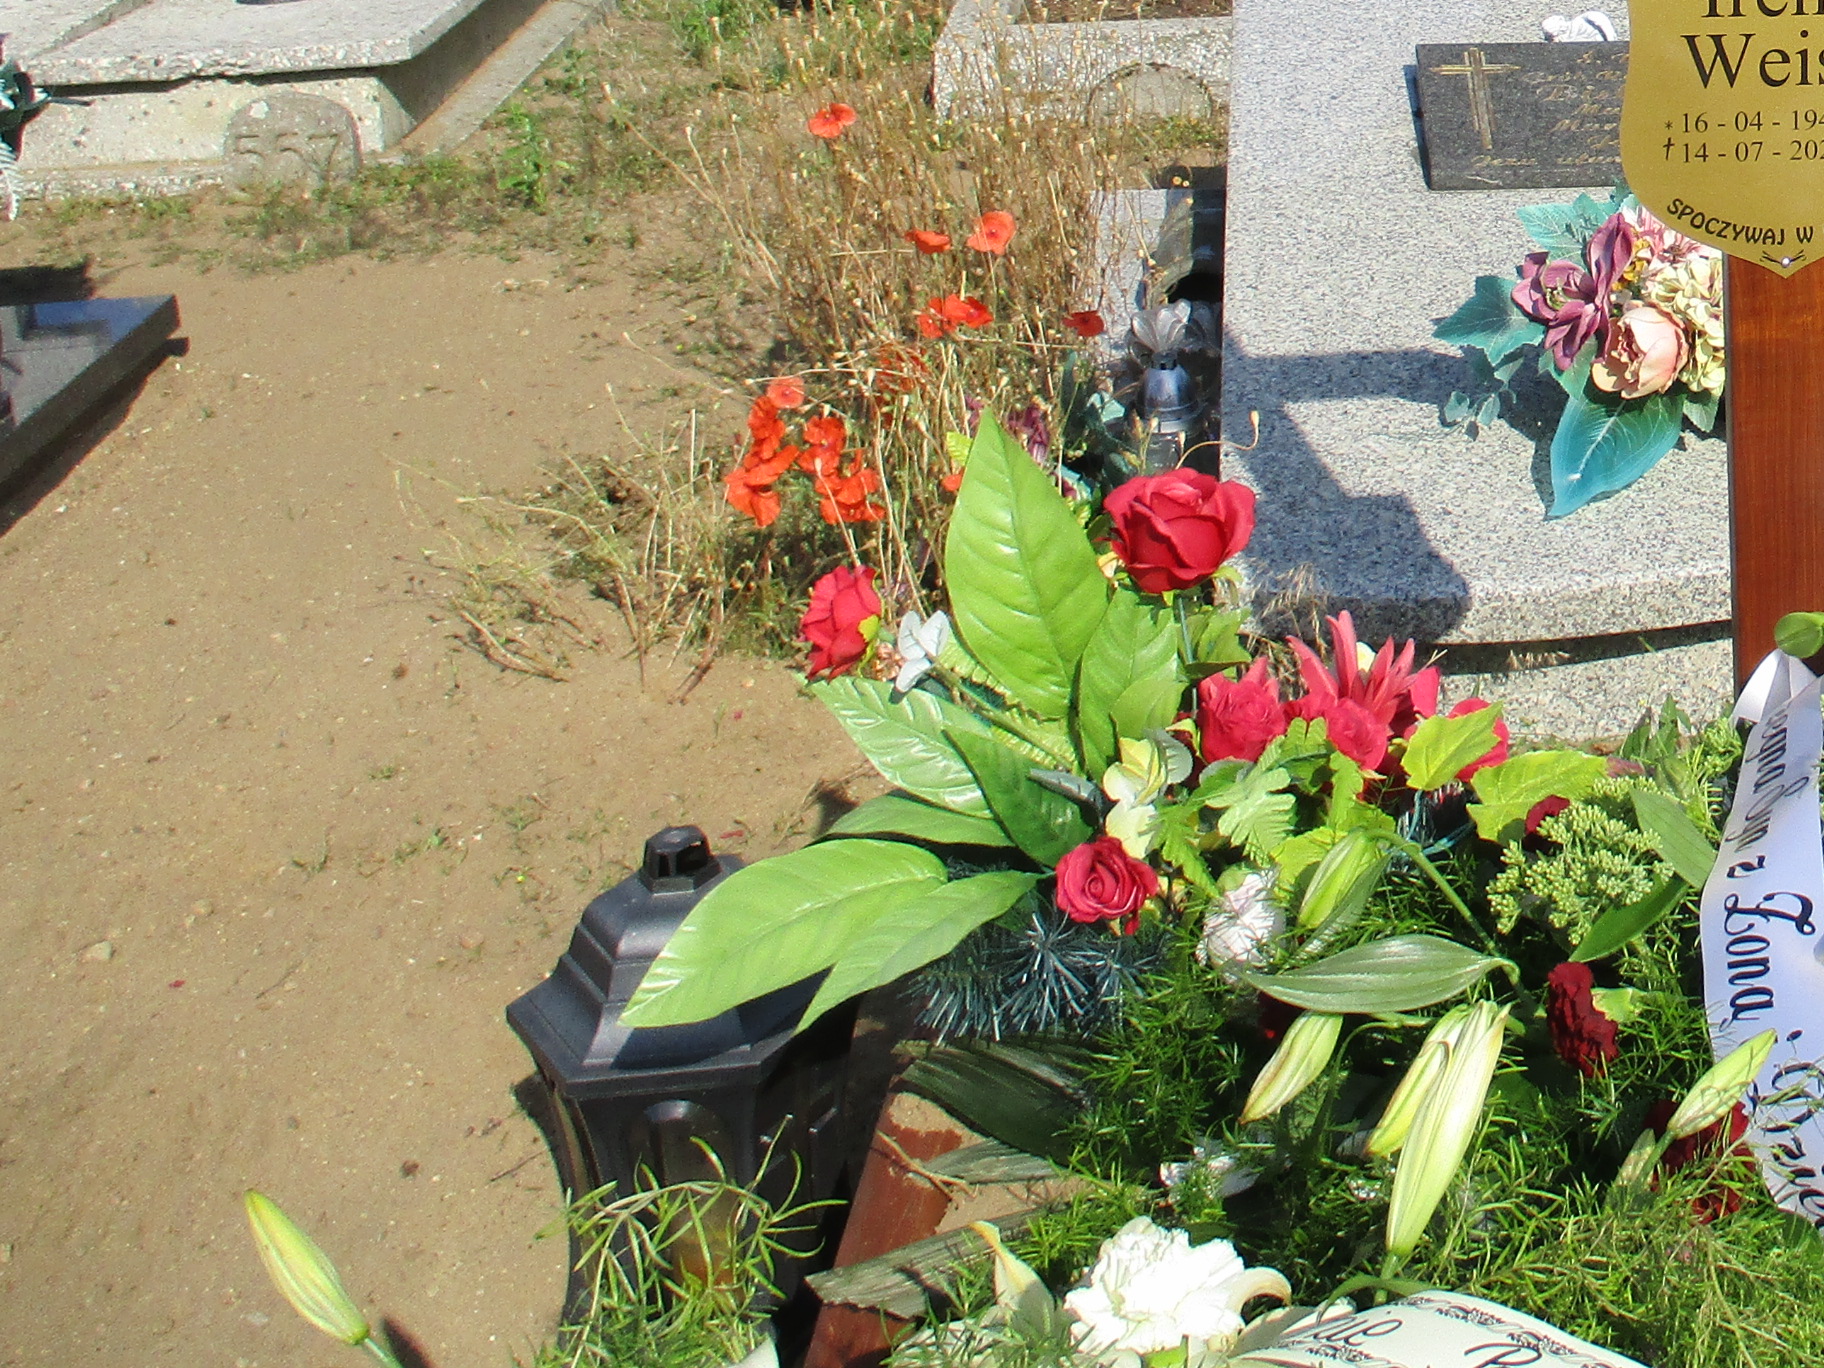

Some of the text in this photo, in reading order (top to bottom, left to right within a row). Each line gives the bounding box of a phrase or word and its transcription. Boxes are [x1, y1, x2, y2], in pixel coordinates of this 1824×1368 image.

[233, 130, 340, 192] 557
[1667, 198, 1785, 246] SPOCZYWAJ
[1796, 225, 1815, 245] W
[1720, 892, 1816, 1032] Żoną
